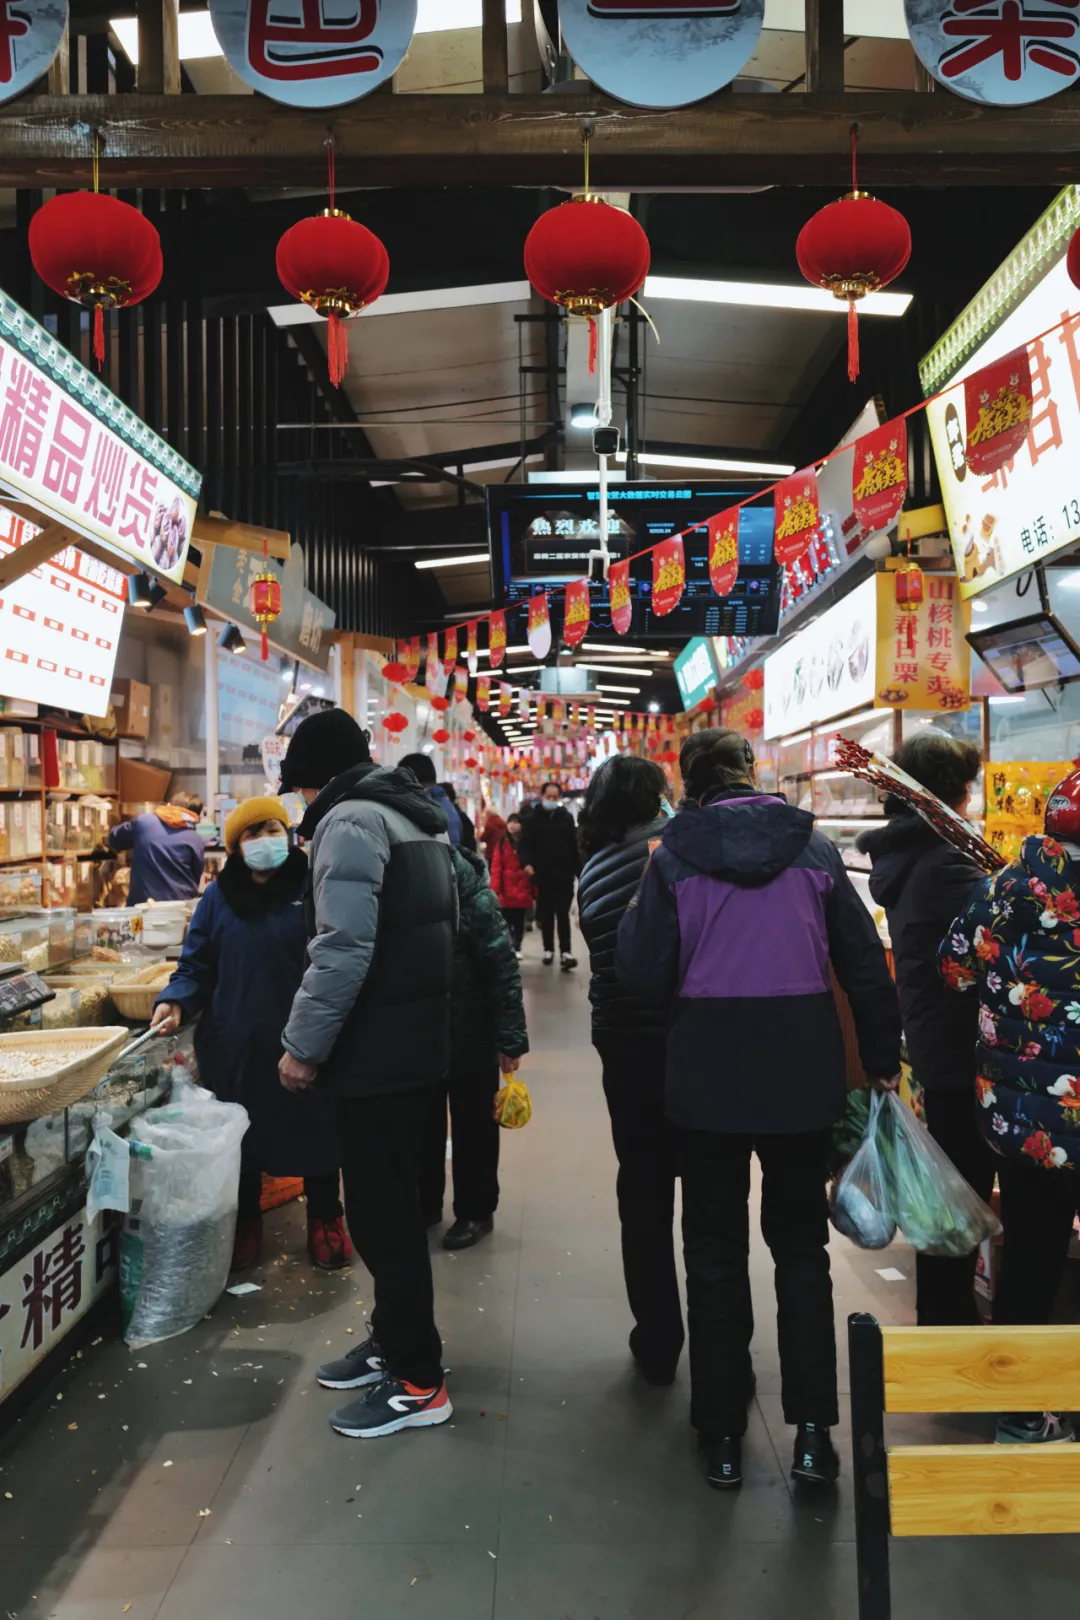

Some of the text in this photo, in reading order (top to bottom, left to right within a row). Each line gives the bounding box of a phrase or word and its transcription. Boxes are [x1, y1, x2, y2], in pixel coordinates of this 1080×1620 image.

[0, 357, 159, 548] 精品炒货
[893, 604, 920, 684] 君甘栗
[927, 580, 953, 697] 山核桃专卖
